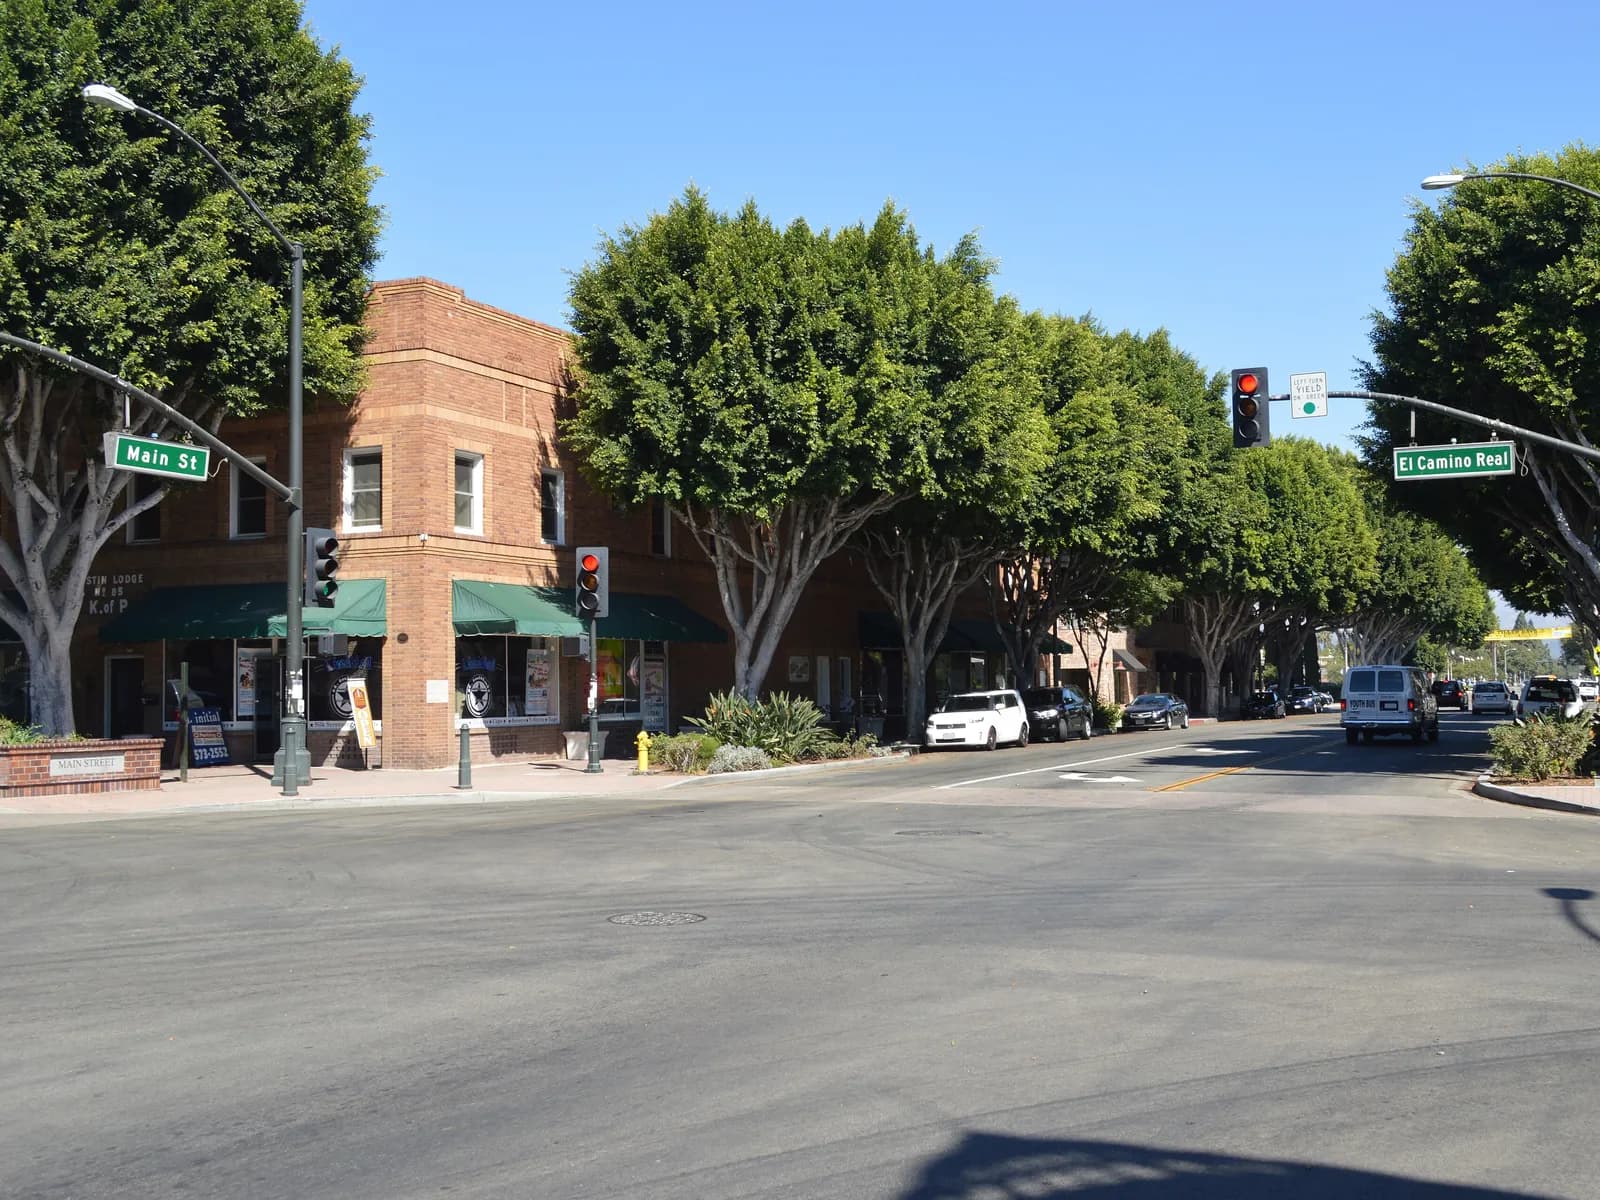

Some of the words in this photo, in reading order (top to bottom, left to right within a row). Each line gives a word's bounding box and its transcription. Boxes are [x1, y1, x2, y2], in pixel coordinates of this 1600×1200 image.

[1296, 383, 1322, 393] YIELD
[127, 445, 168, 466] Main
[178, 453, 198, 470] St
[1399, 457, 1413, 471] El
[1417, 454, 1472, 471] Camino
[1476, 451, 1508, 467] Real
[86, 575, 108, 585] STIN
[112, 573, 144, 585] LODGE
[194, 711, 221, 724] initial
[58, 759, 82, 769] MAIN
[83, 759, 115, 768] STREET
